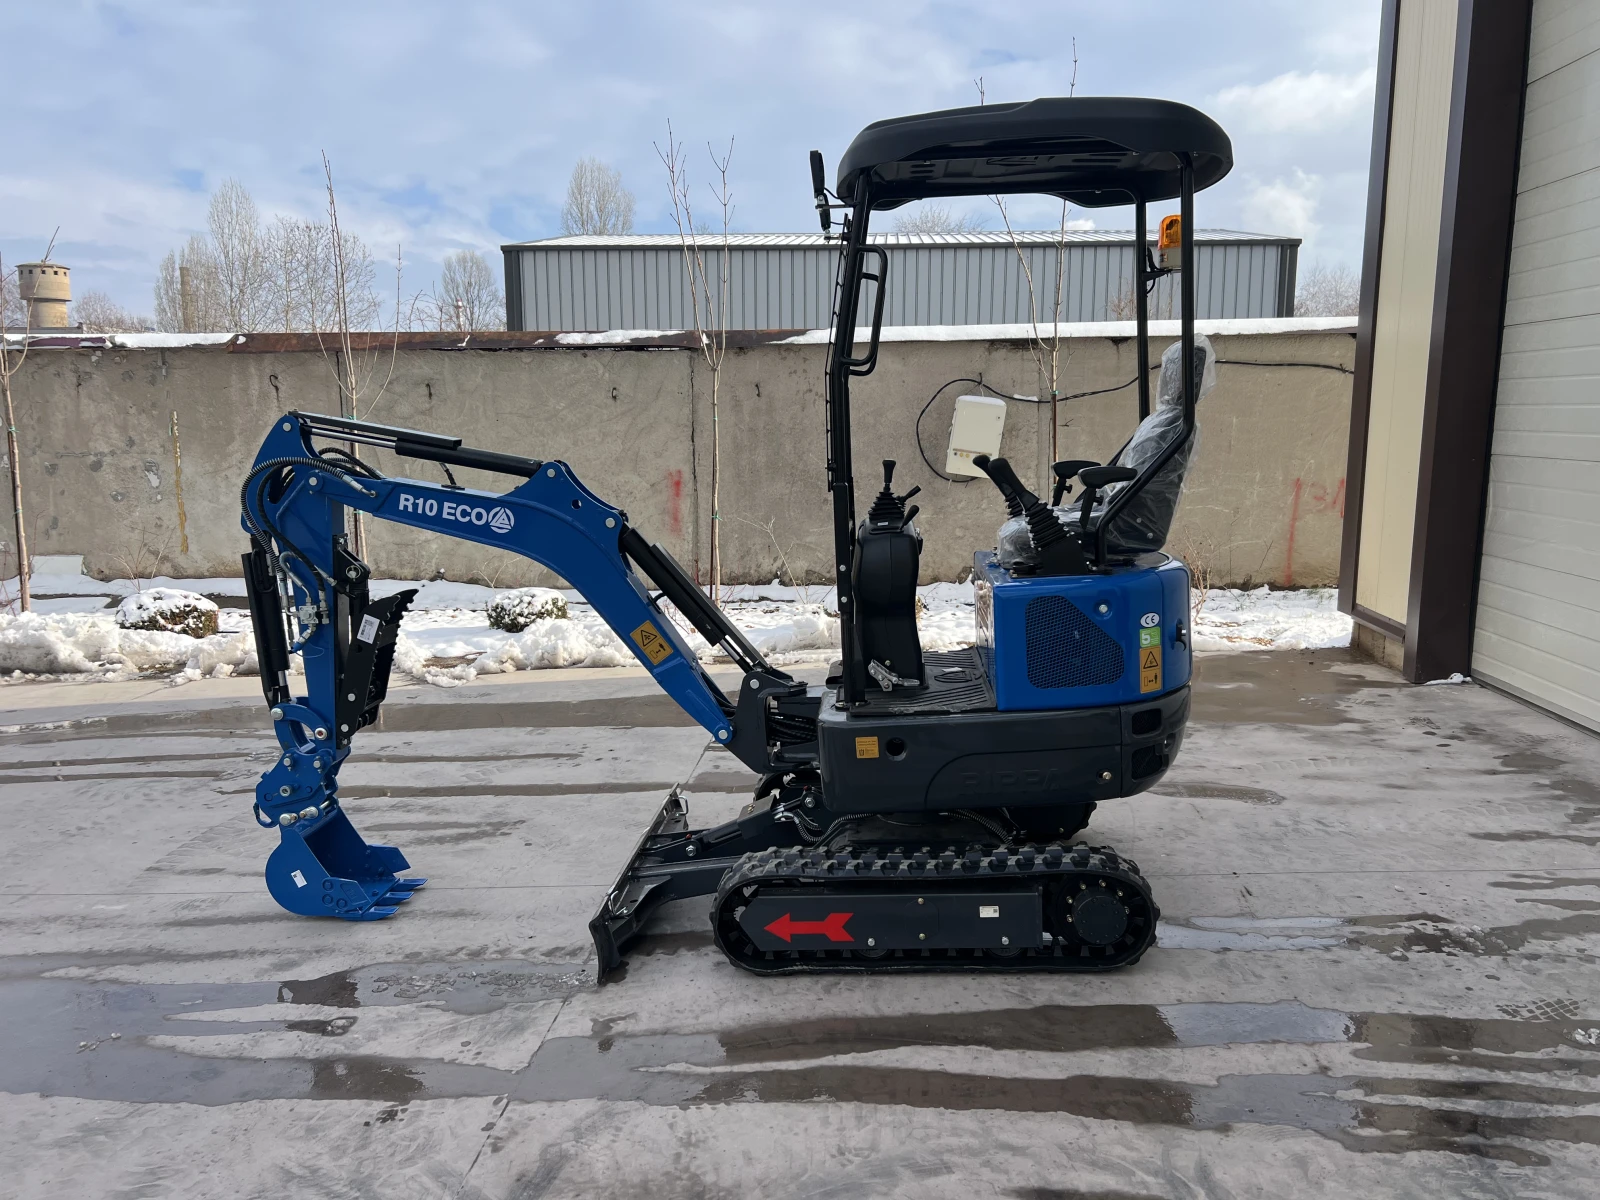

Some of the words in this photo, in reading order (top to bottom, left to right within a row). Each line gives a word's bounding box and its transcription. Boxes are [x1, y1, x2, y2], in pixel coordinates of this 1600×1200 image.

[398, 493, 438, 517] R10
[442, 501, 488, 526] ECO
[1144, 614, 1156, 626] CE
[1141, 632, 1151, 645] 5
